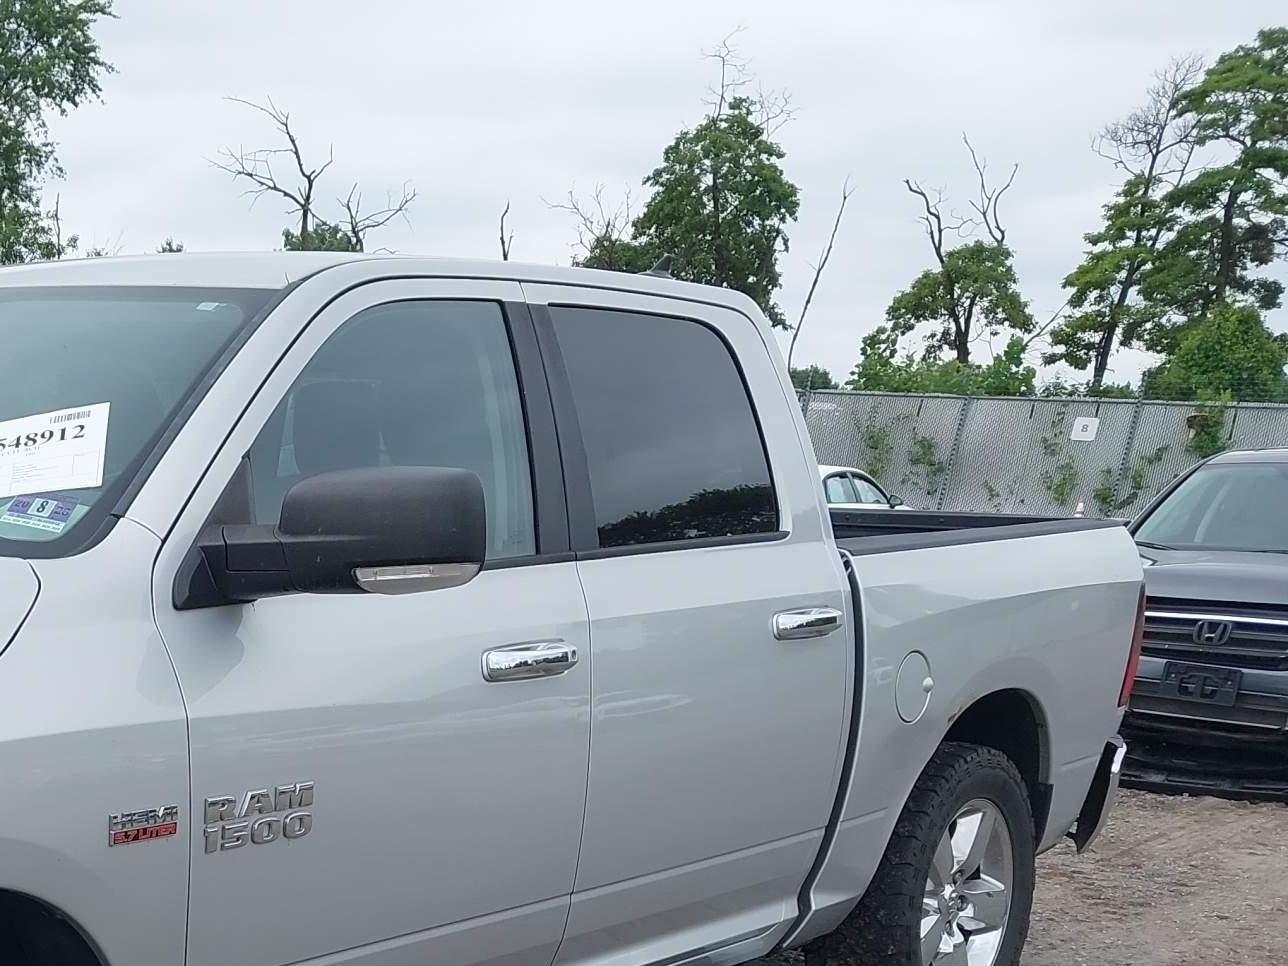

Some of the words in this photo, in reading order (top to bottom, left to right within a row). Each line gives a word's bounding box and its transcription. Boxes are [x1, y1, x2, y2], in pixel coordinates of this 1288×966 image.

[1081, 424, 1089, 433] 8
[36, 500, 49, 513] 8
[204, 781, 314, 825] RAM
[109, 804, 178, 831] HEMI
[114, 831, 138, 843] 5.7
[138, 823, 177, 840] LITER
[203, 810, 314, 854] 1500
